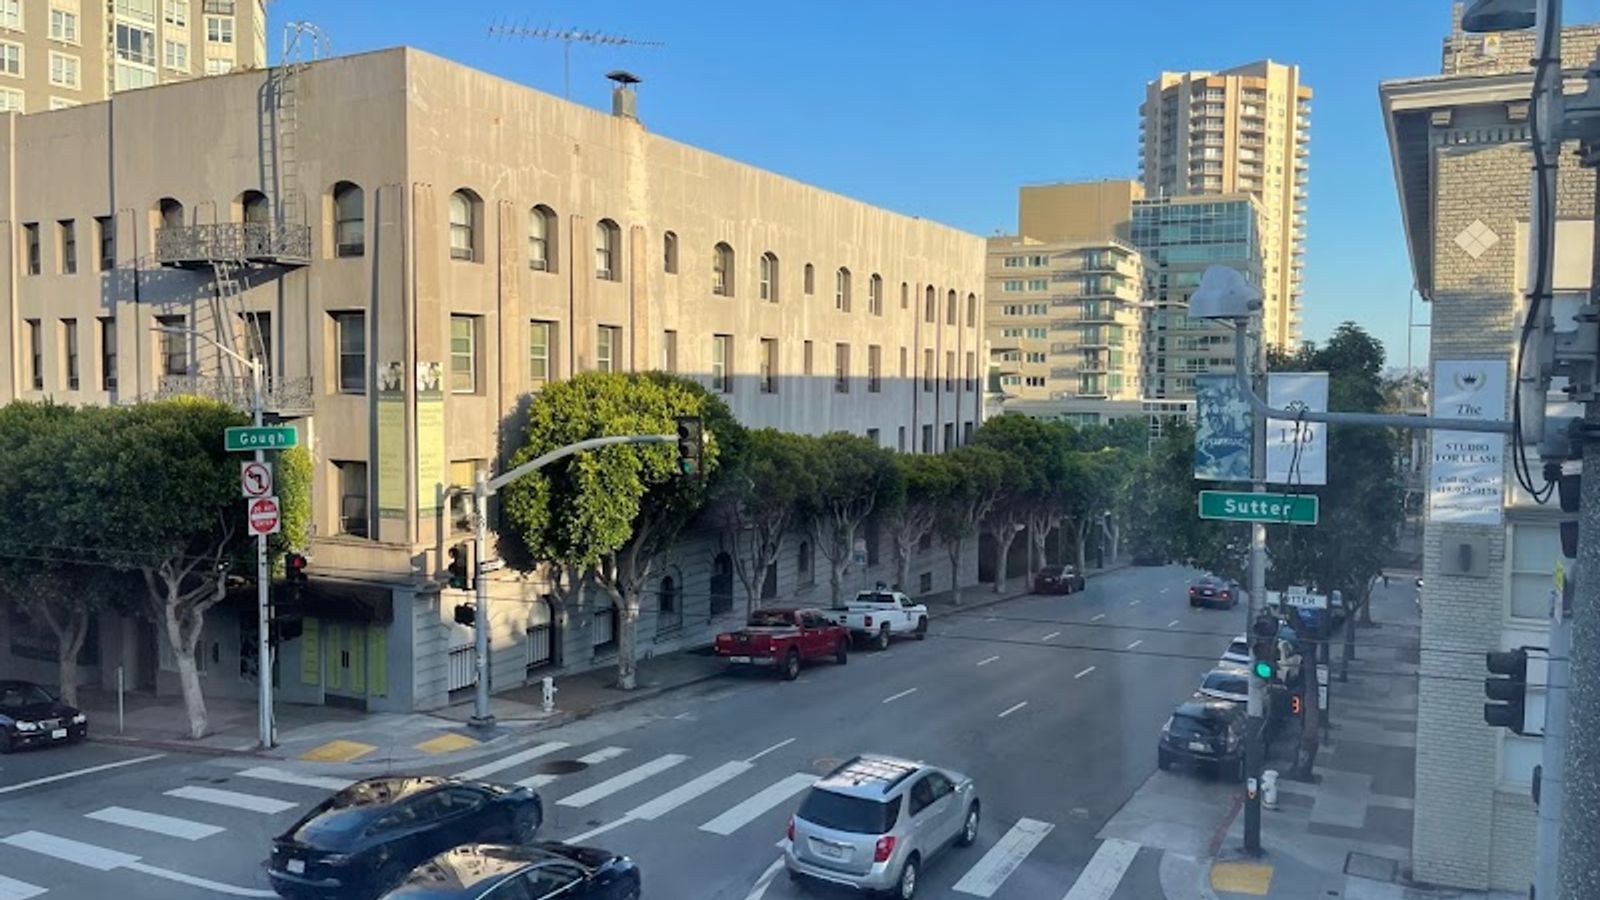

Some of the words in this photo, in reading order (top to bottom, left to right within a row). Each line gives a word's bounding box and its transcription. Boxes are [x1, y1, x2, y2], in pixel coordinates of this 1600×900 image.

[1456, 404, 1482, 415] The
[240, 432, 285, 446] Gough
[1280, 428, 1313, 443] 170
[1446, 443, 1490, 451] STUDIO
[1436, 454, 1459, 462] FOR
[1461, 454, 1496, 463] LEASE
[1224, 498, 1291, 516] Sutter
